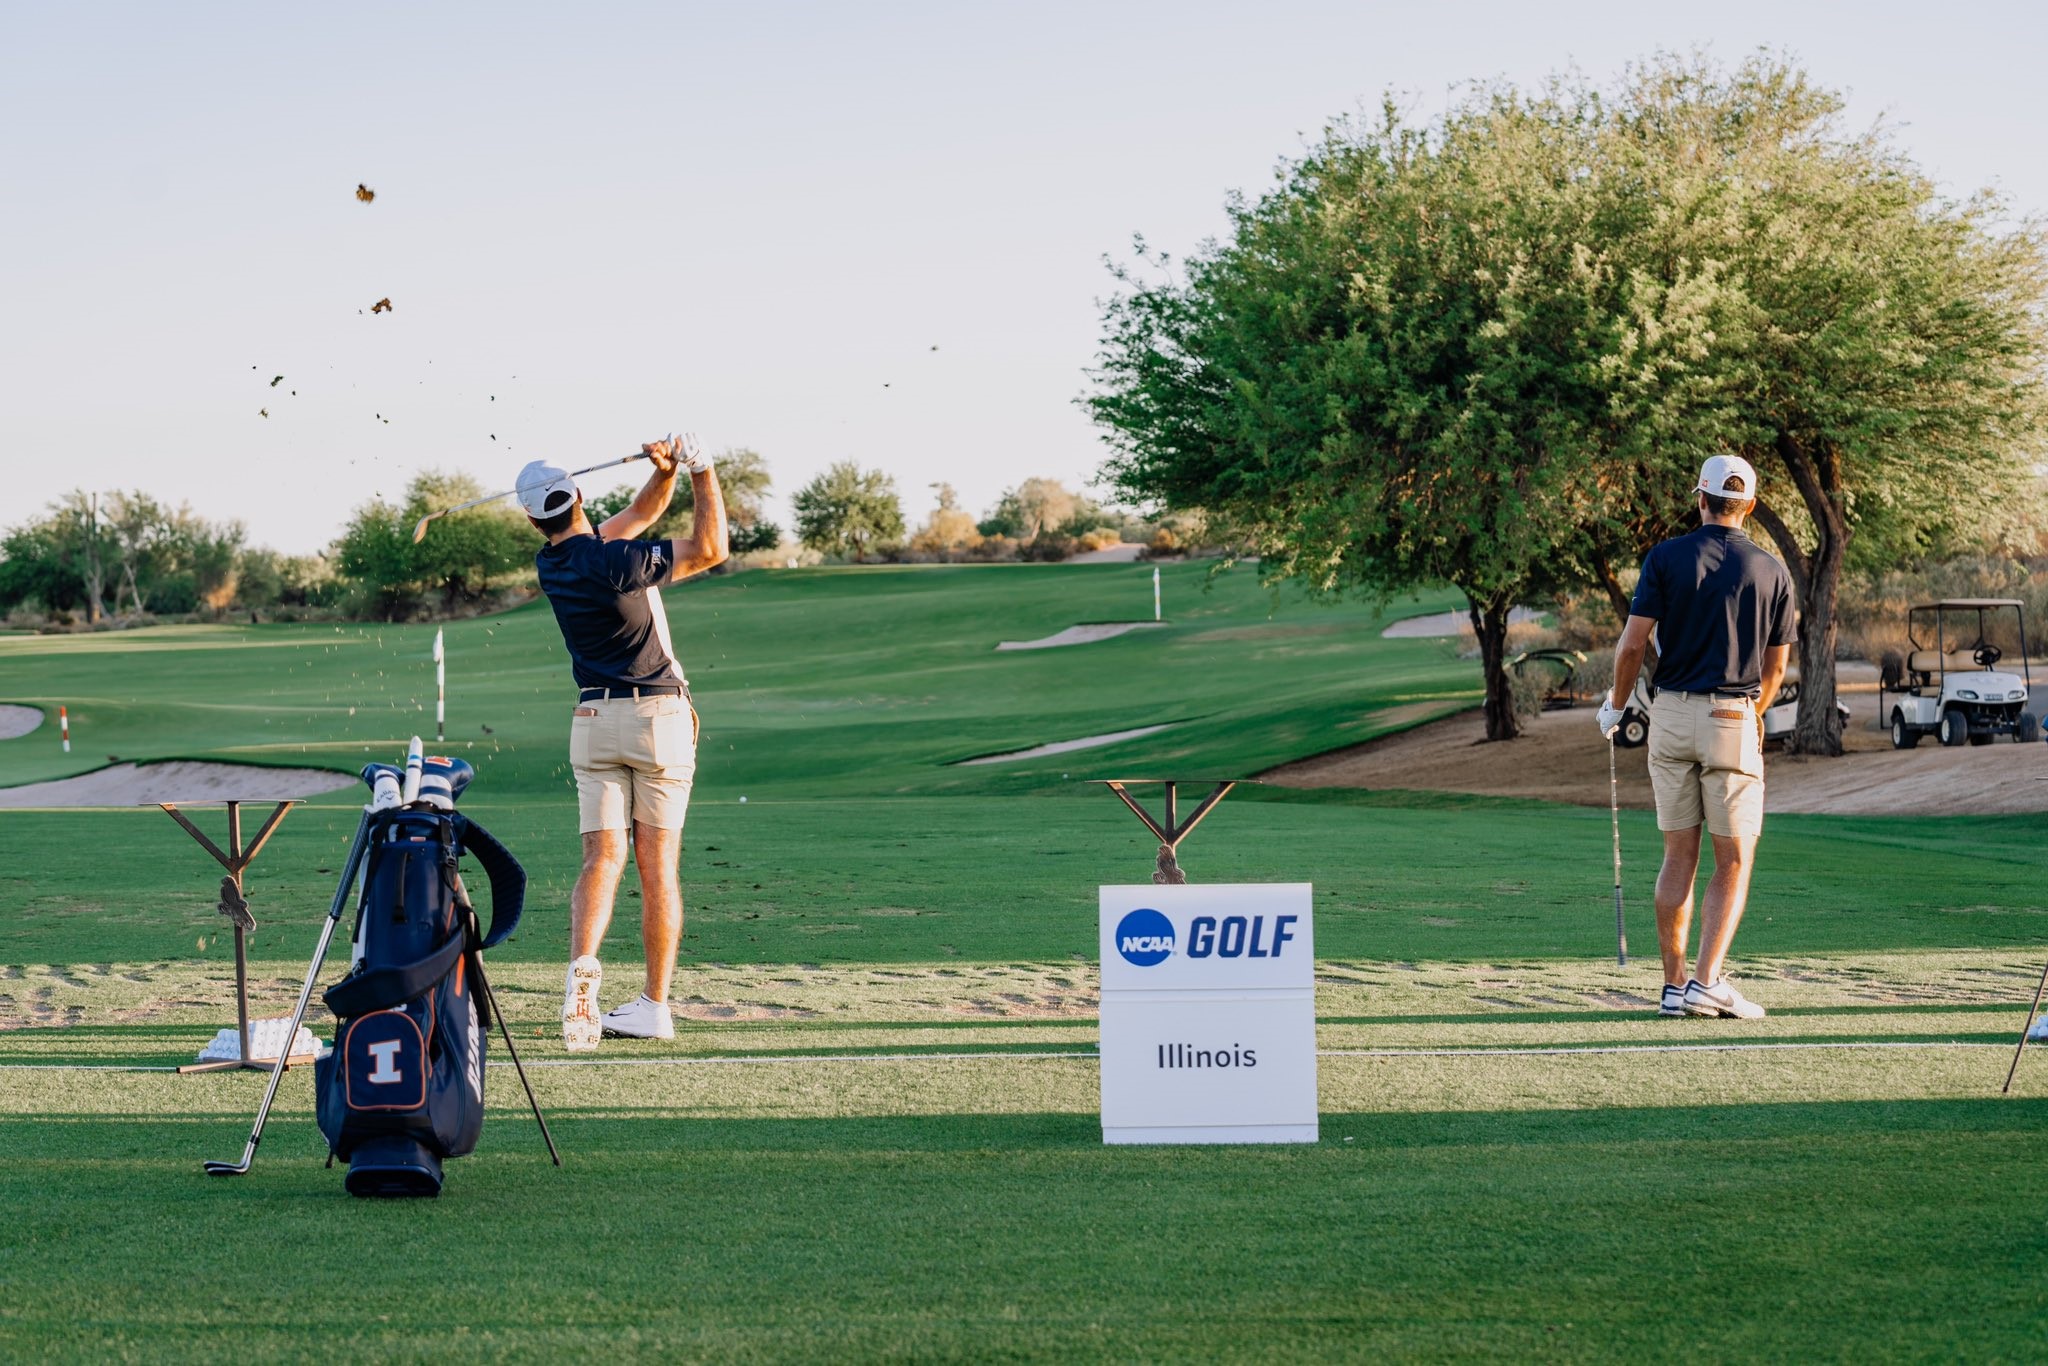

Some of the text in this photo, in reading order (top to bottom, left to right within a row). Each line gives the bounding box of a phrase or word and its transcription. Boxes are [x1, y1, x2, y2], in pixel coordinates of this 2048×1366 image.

[1121, 915, 1298, 958] NCAA GOLF
[368, 1039, 402, 1084] I
[1158, 1043, 1257, 1069] Illinois
